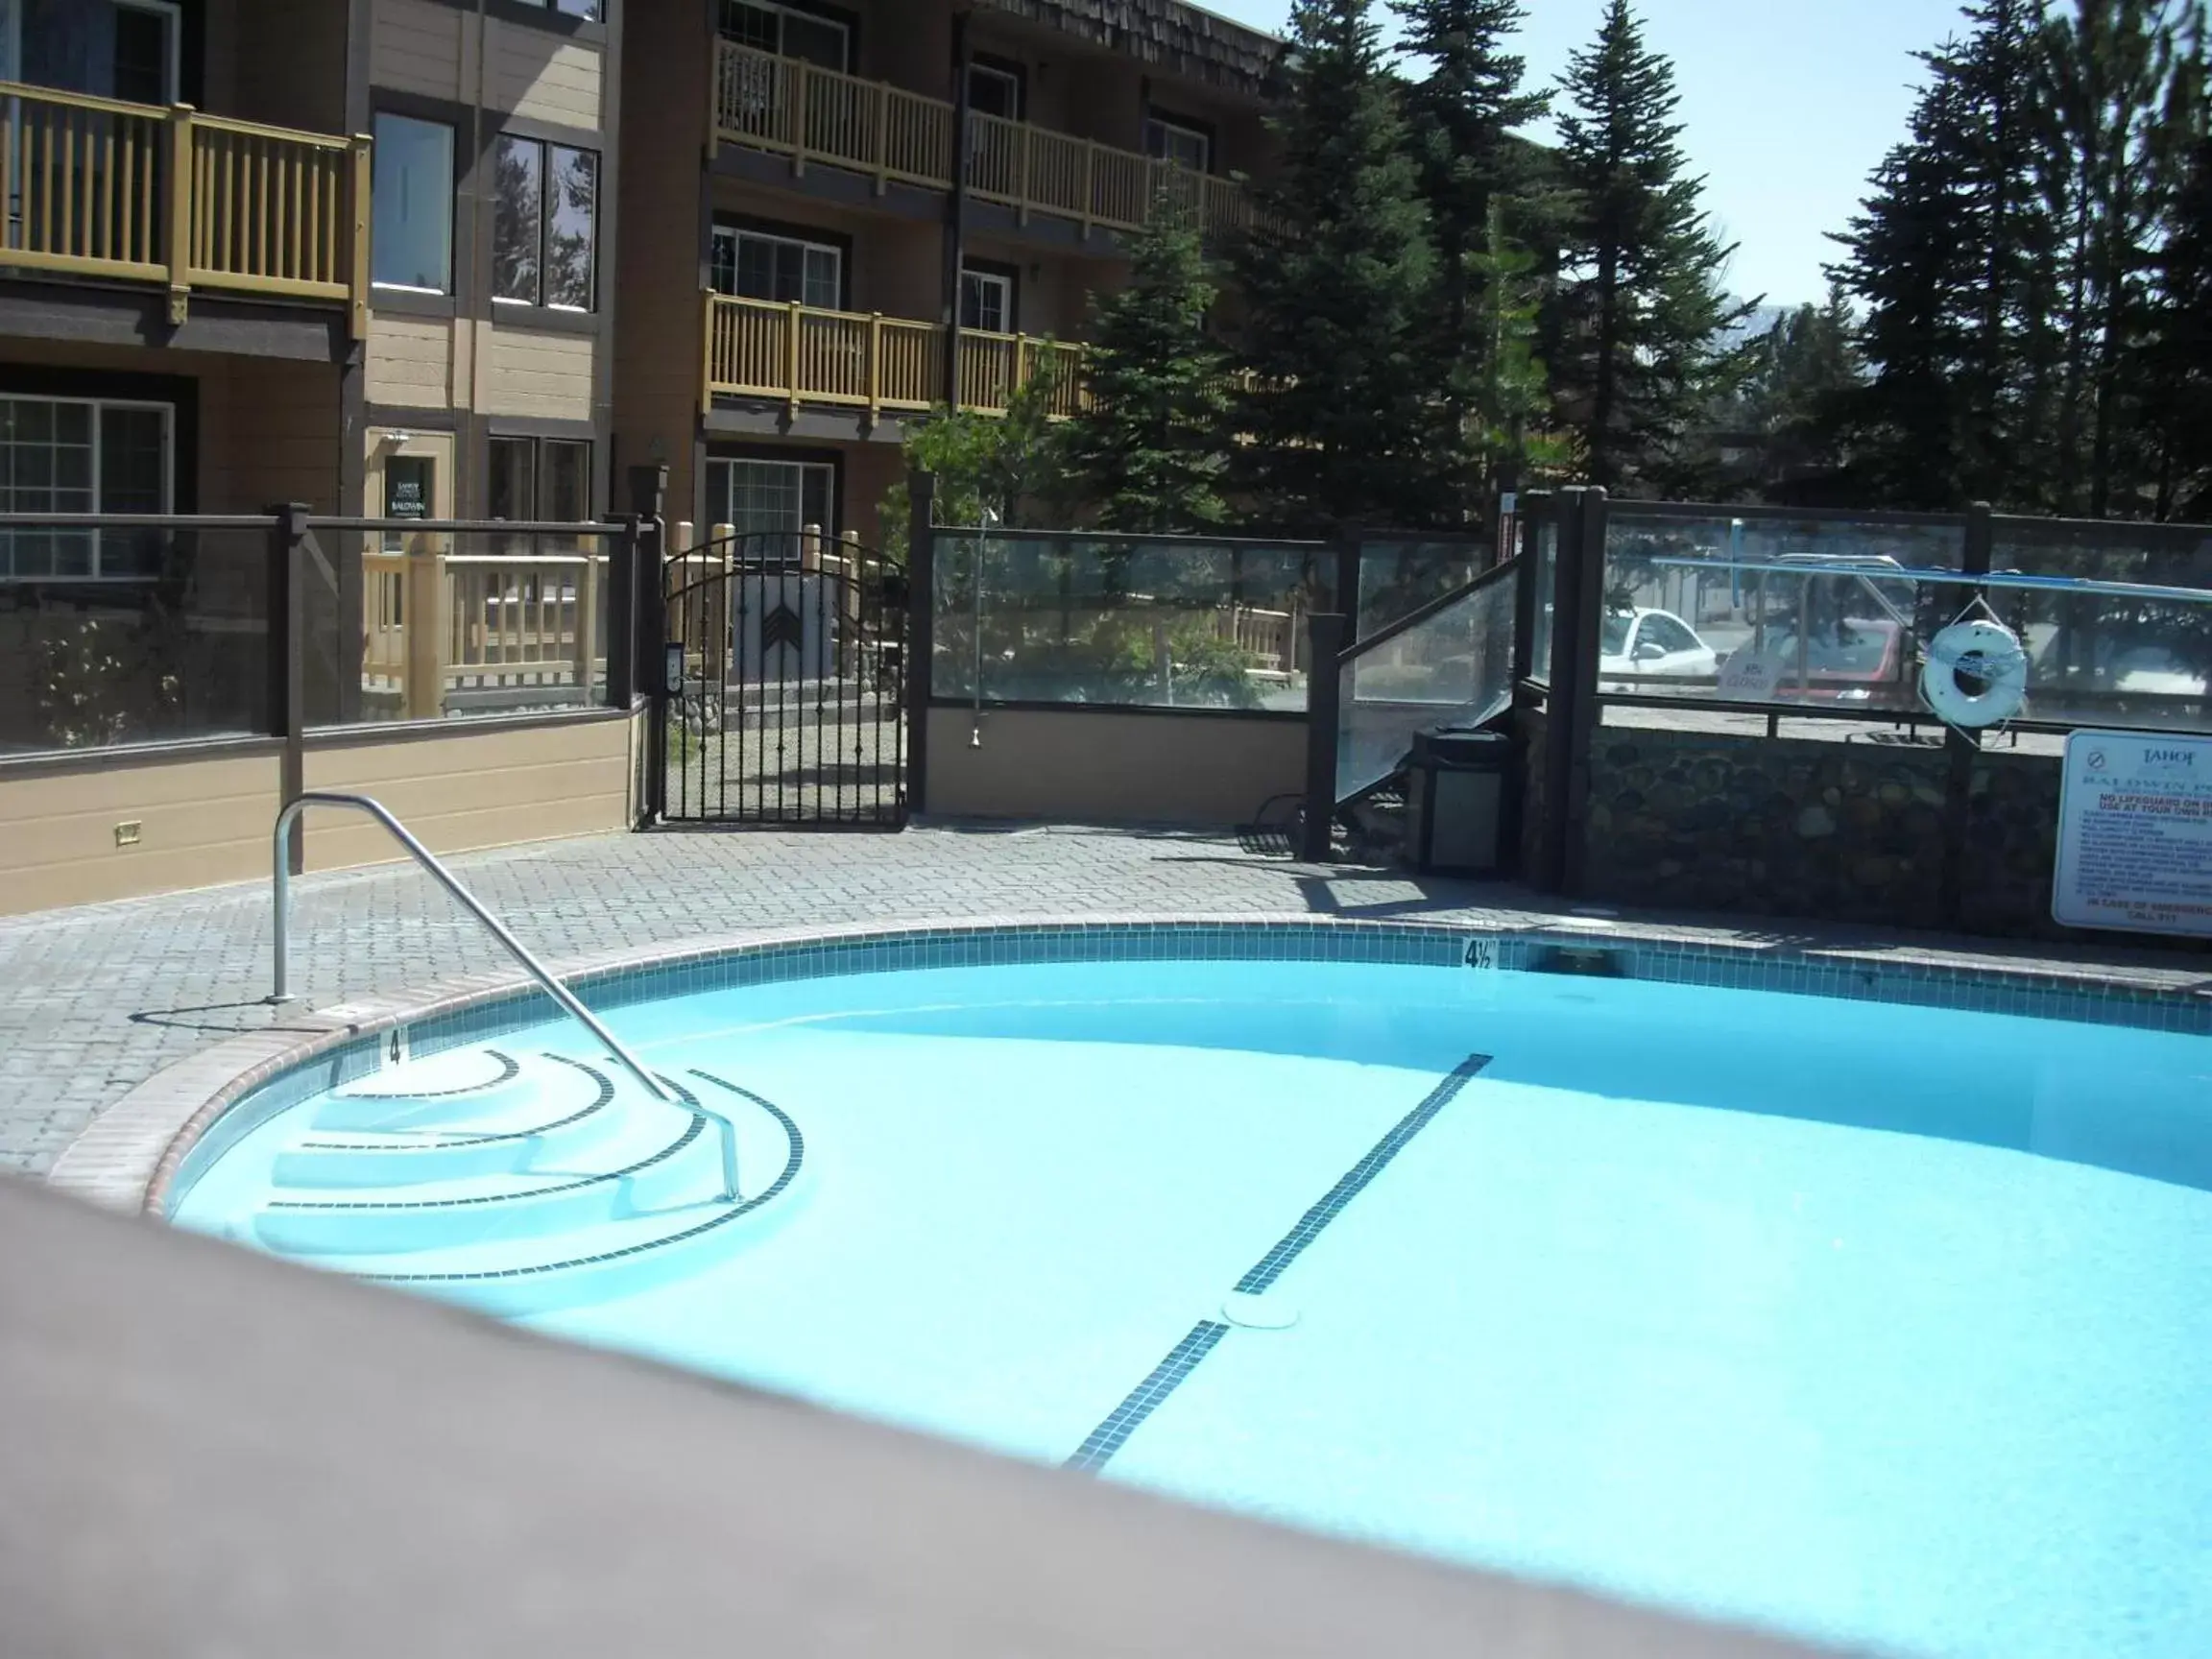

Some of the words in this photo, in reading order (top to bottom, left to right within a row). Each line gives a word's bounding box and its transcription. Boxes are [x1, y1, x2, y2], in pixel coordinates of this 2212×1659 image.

[392, 501, 426, 512] BALDWIN
[2082, 776, 2185, 789] BALDWIN
[2099, 793, 2115, 803] NO
[2119, 795, 2180, 806] LIFEGUARD
[2183, 799, 2200, 807] ON
[2099, 801, 2119, 811] USE
[2123, 804, 2137, 812] AT
[2142, 805, 2171, 815] YOUR
[2175, 806, 2200, 816] OWN
[2102, 899, 2129, 909] CASE
[390, 1029, 400, 1066] 4
